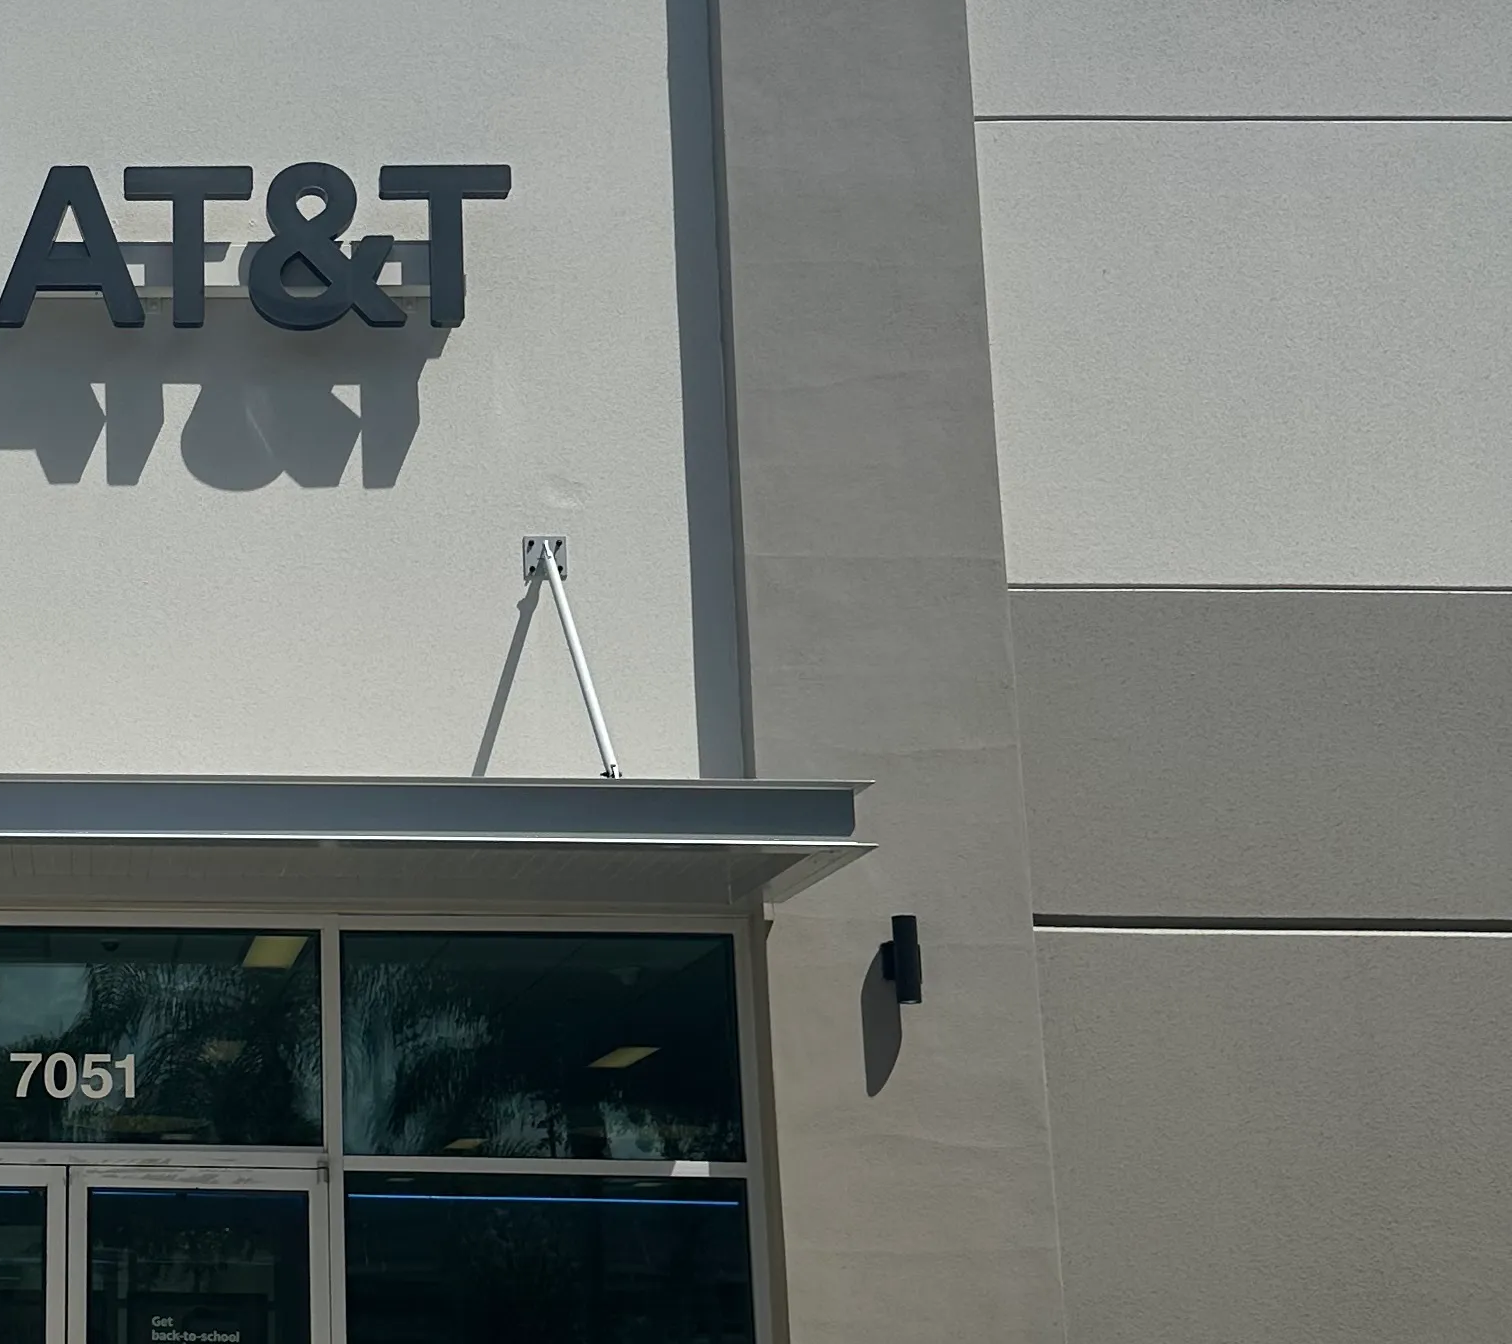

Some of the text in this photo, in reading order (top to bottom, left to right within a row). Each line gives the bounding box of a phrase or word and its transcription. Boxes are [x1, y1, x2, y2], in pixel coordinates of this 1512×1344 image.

[9, 1052, 136, 1100] 7051
[151, 1316, 174, 1328] Get
[151, 1329, 240, 1343] back-to-school
